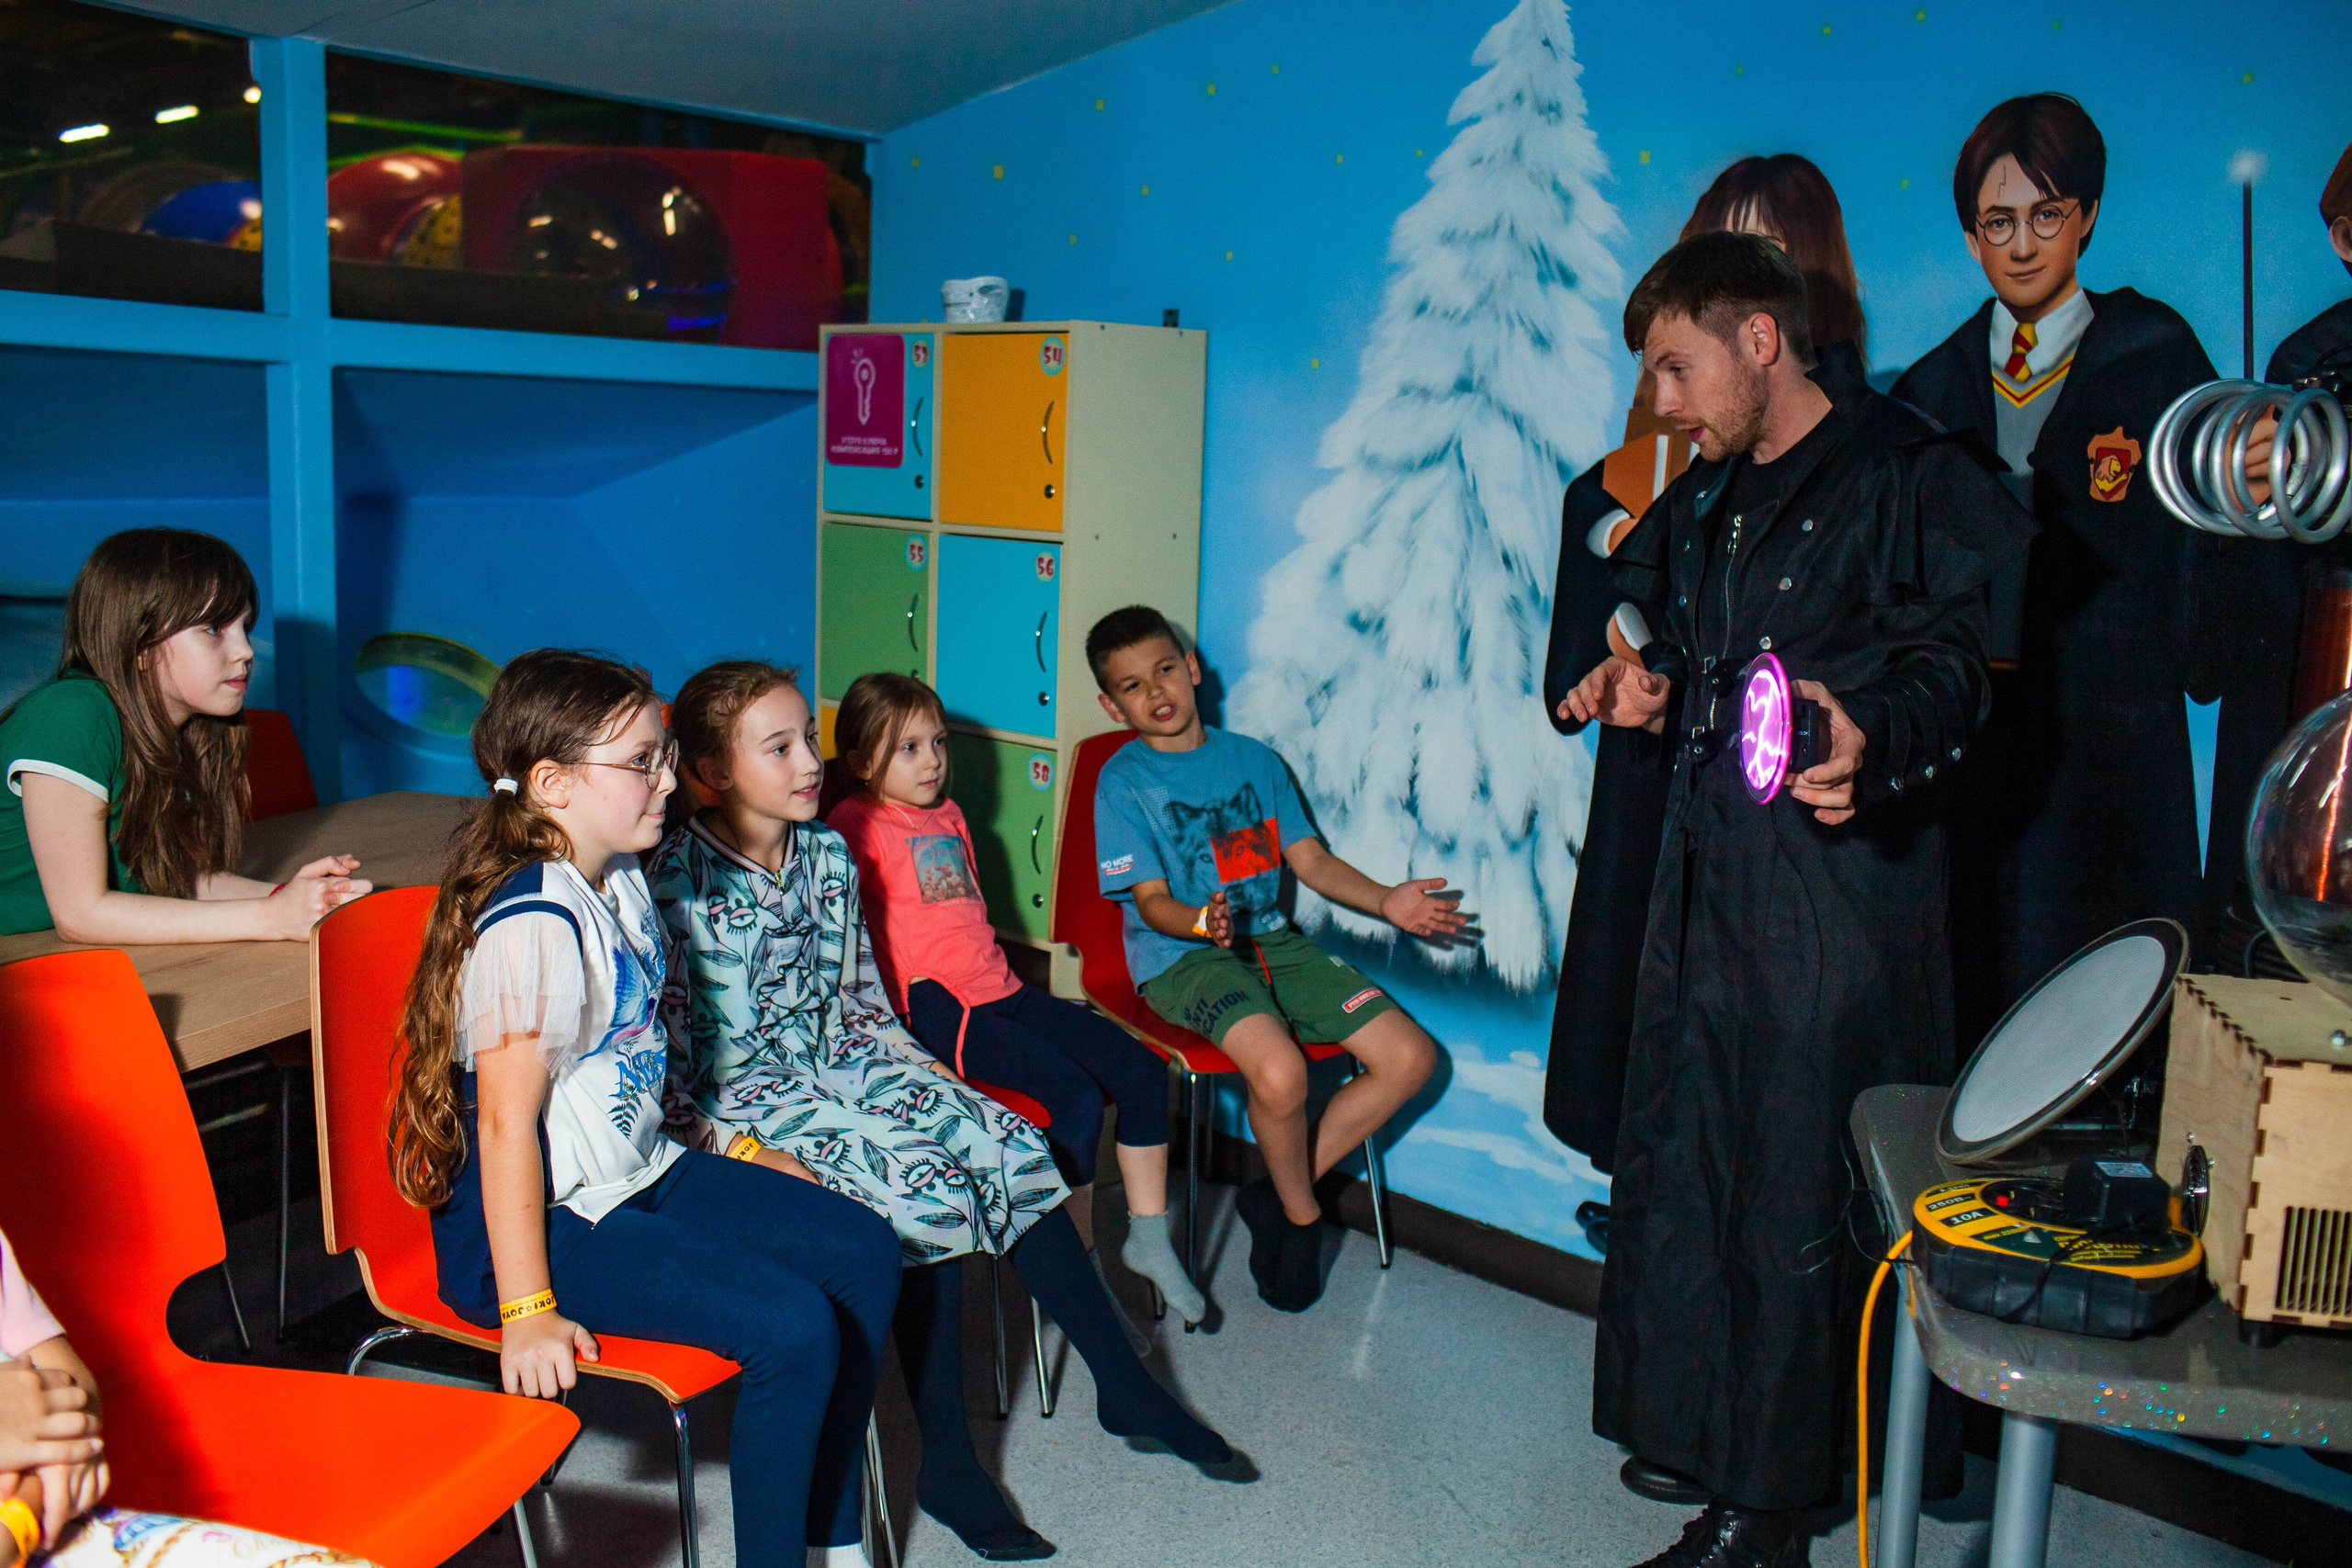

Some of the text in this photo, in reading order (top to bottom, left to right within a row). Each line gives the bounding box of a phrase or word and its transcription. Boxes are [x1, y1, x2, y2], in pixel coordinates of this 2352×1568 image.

[1044, 345, 1062, 366] 54
[910, 544, 923, 562] 55
[1037, 557, 1054, 577] 56
[1033, 761, 1050, 783] 58
[1101, 854, 1134, 870] NO MORE
